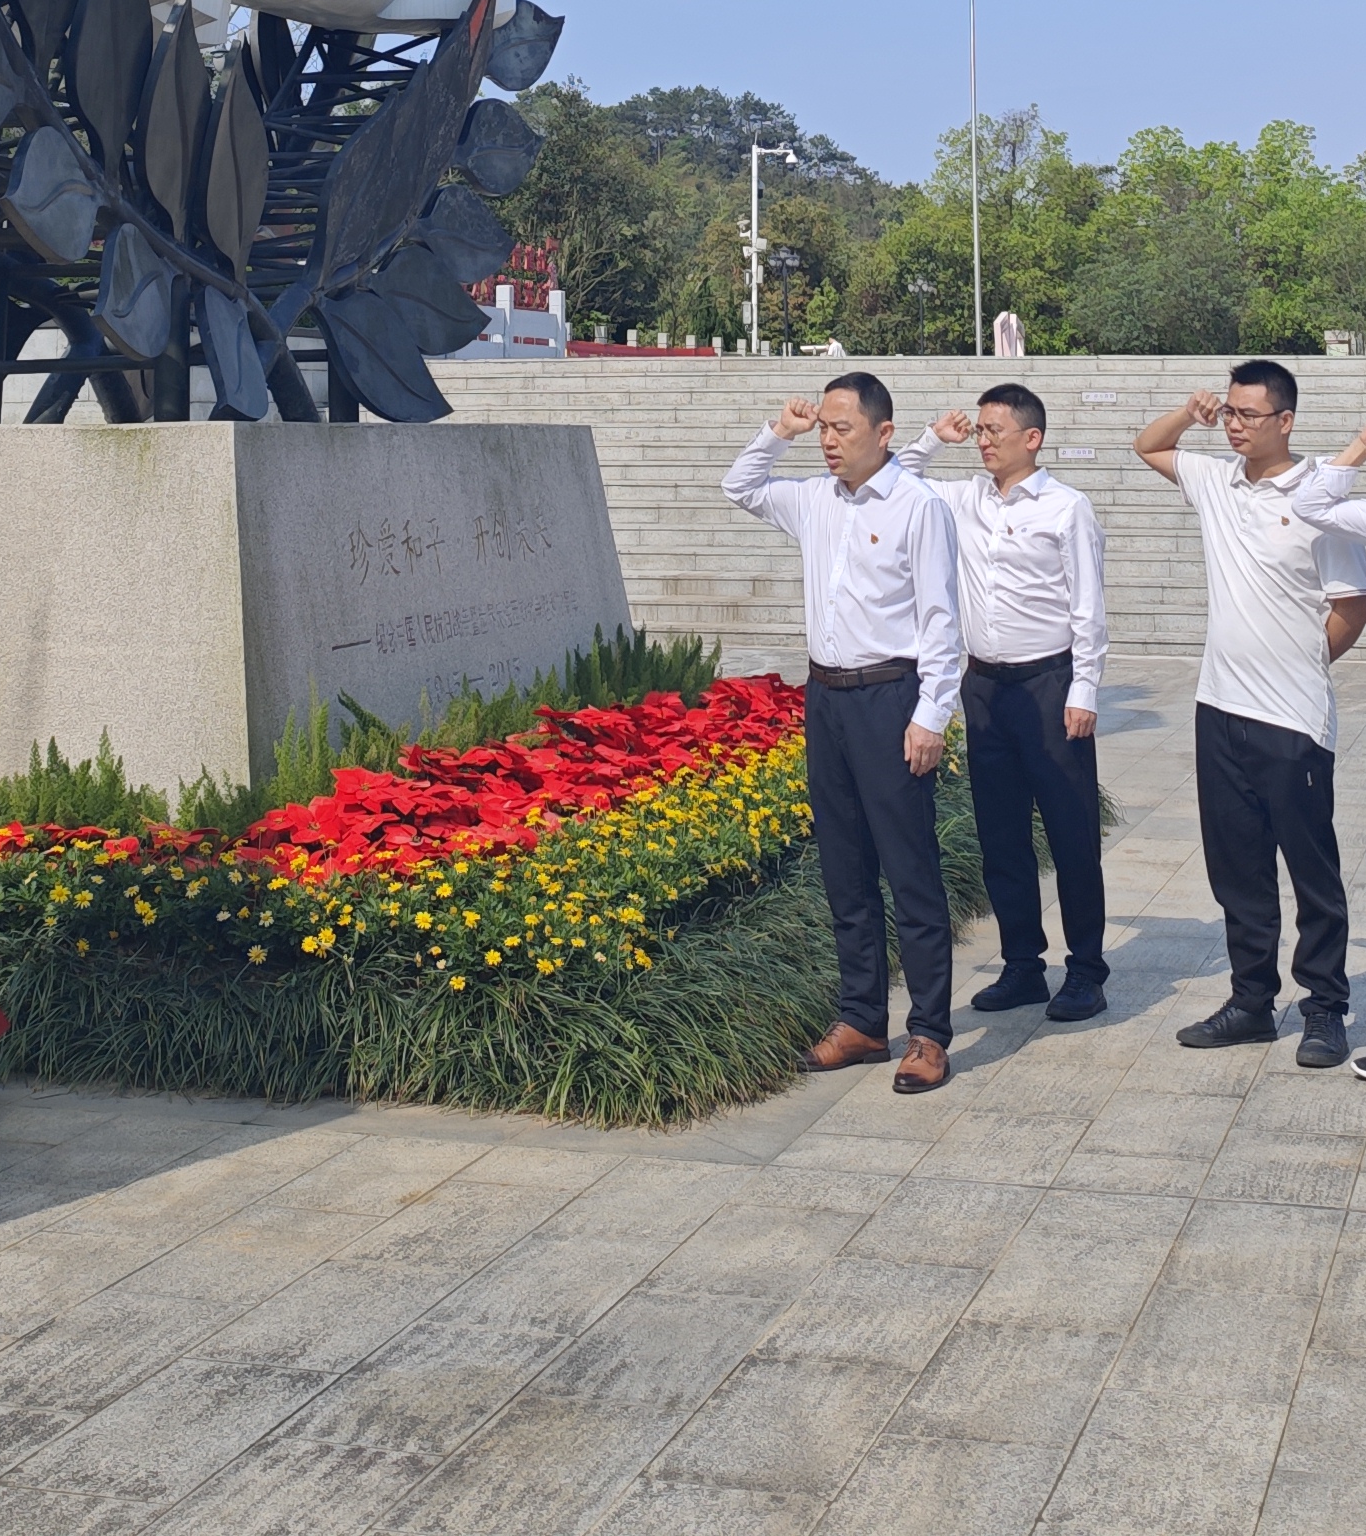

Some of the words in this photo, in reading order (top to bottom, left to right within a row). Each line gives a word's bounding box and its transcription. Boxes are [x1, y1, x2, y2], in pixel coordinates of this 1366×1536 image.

[348, 518, 445, 586] 珍爱和平
[473, 511, 552, 561] 开创未来
